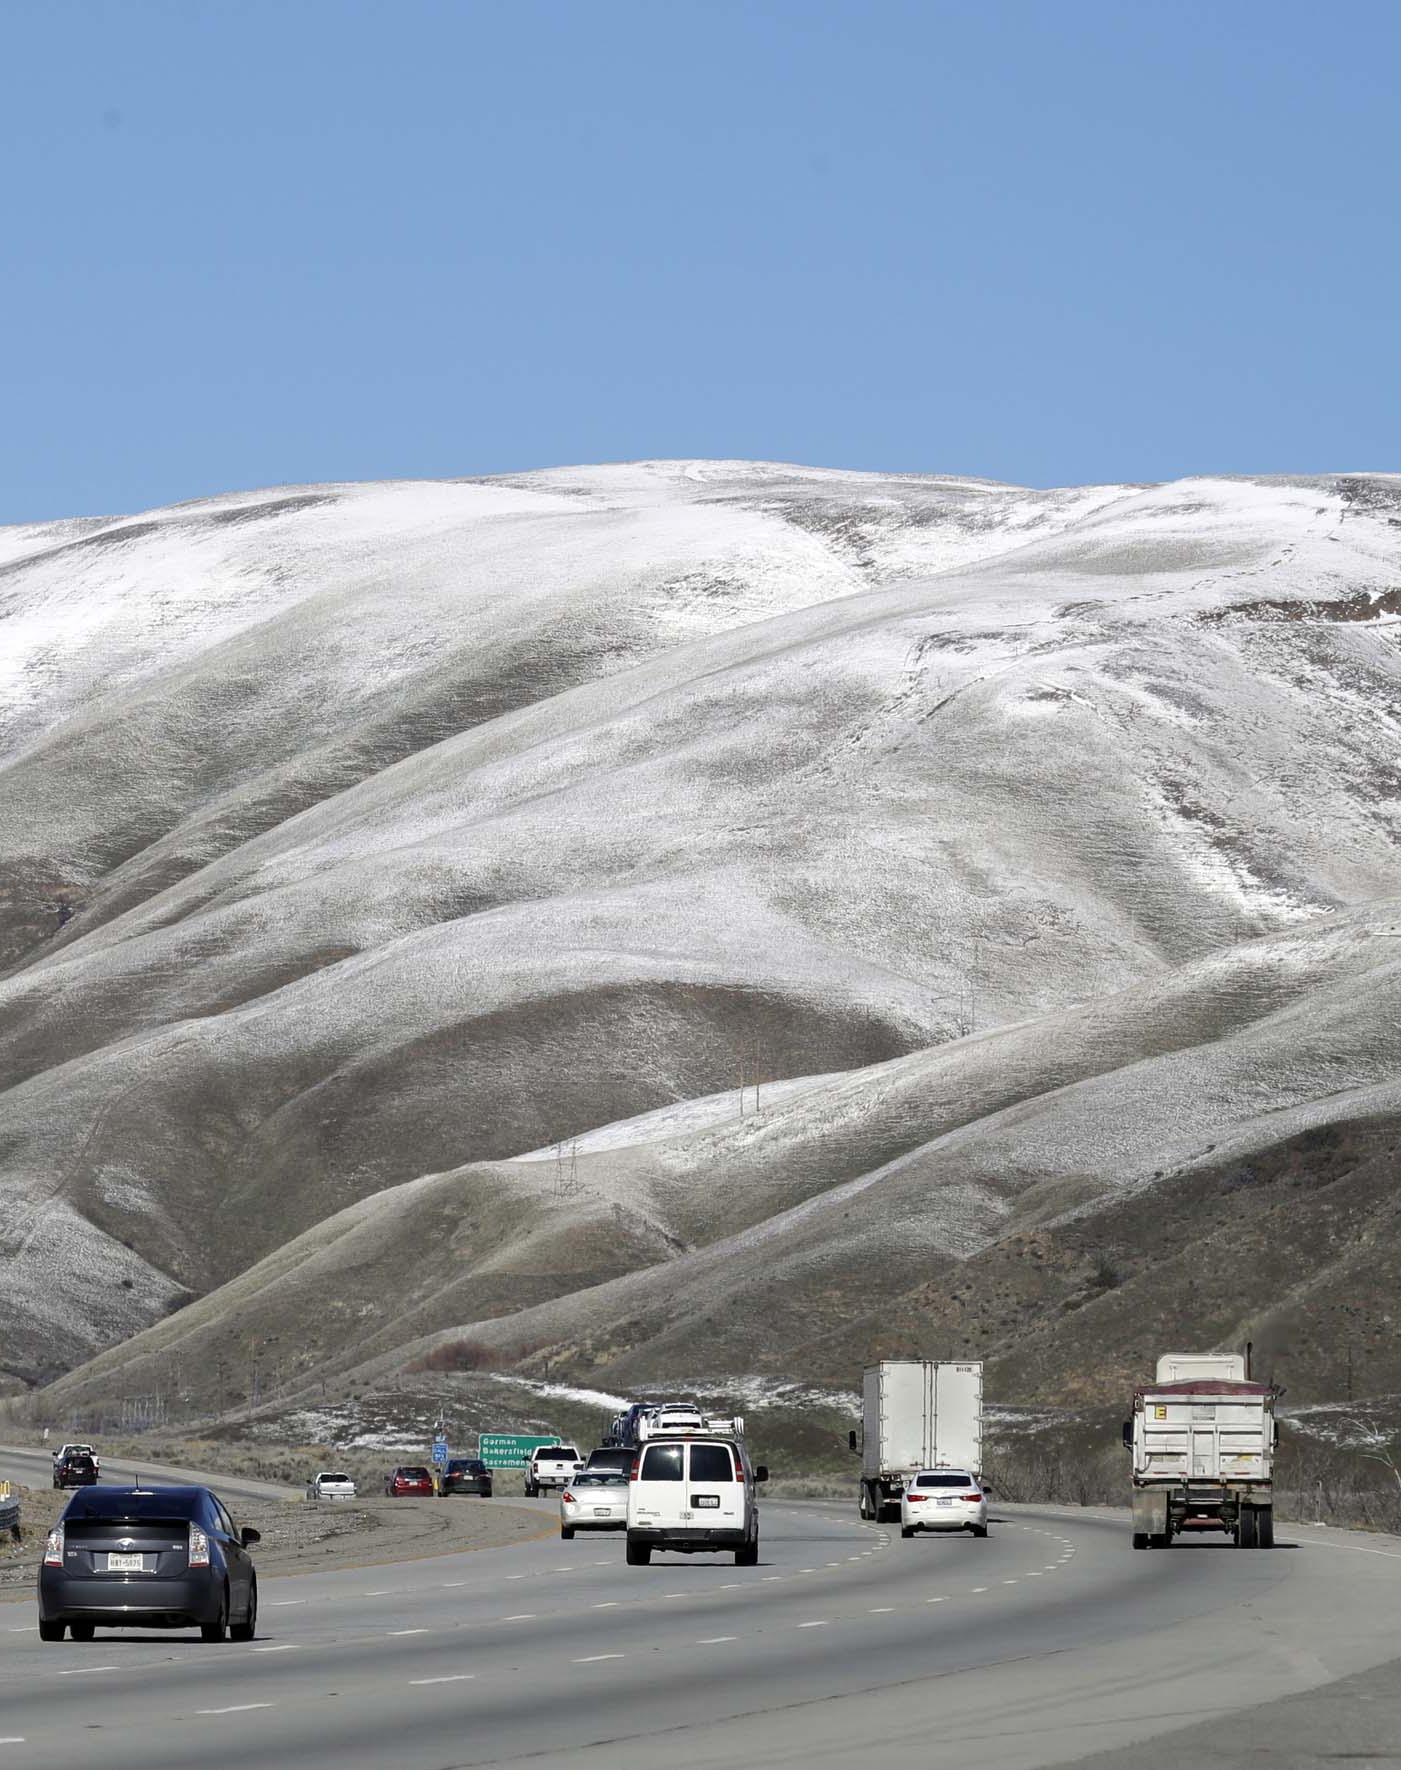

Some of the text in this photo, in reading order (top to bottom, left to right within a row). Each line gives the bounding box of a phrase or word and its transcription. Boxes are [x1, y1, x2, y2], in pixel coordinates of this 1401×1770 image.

[1156, 1406, 1166, 1418] E
[483, 1438, 517, 1446] Gorman
[482, 1447, 532, 1456] Bakersfield
